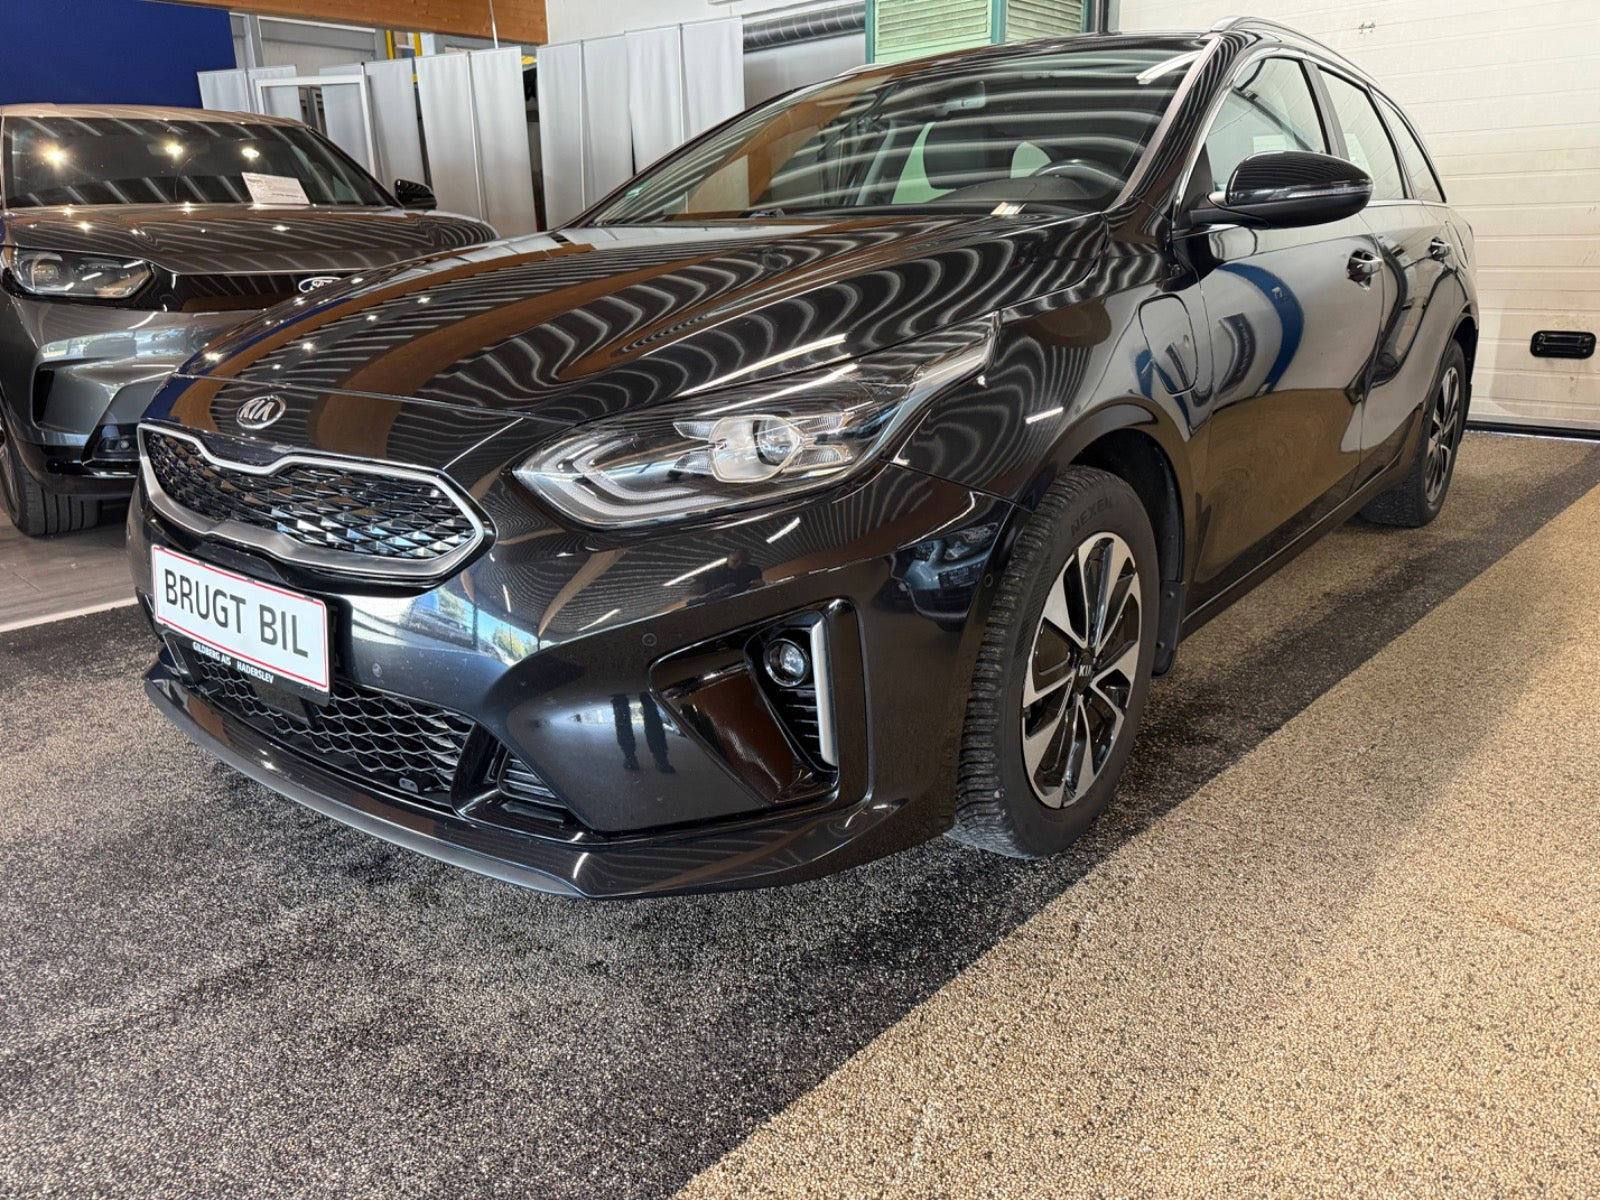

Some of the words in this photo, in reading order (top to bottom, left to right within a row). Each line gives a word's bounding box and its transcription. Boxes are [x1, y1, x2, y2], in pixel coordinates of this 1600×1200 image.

[239, 399, 275, 422] KIA
[164, 568, 246, 634] BRUGT
[259, 603, 308, 658] BIL
[236, 660, 274, 684] HADERSLEV
